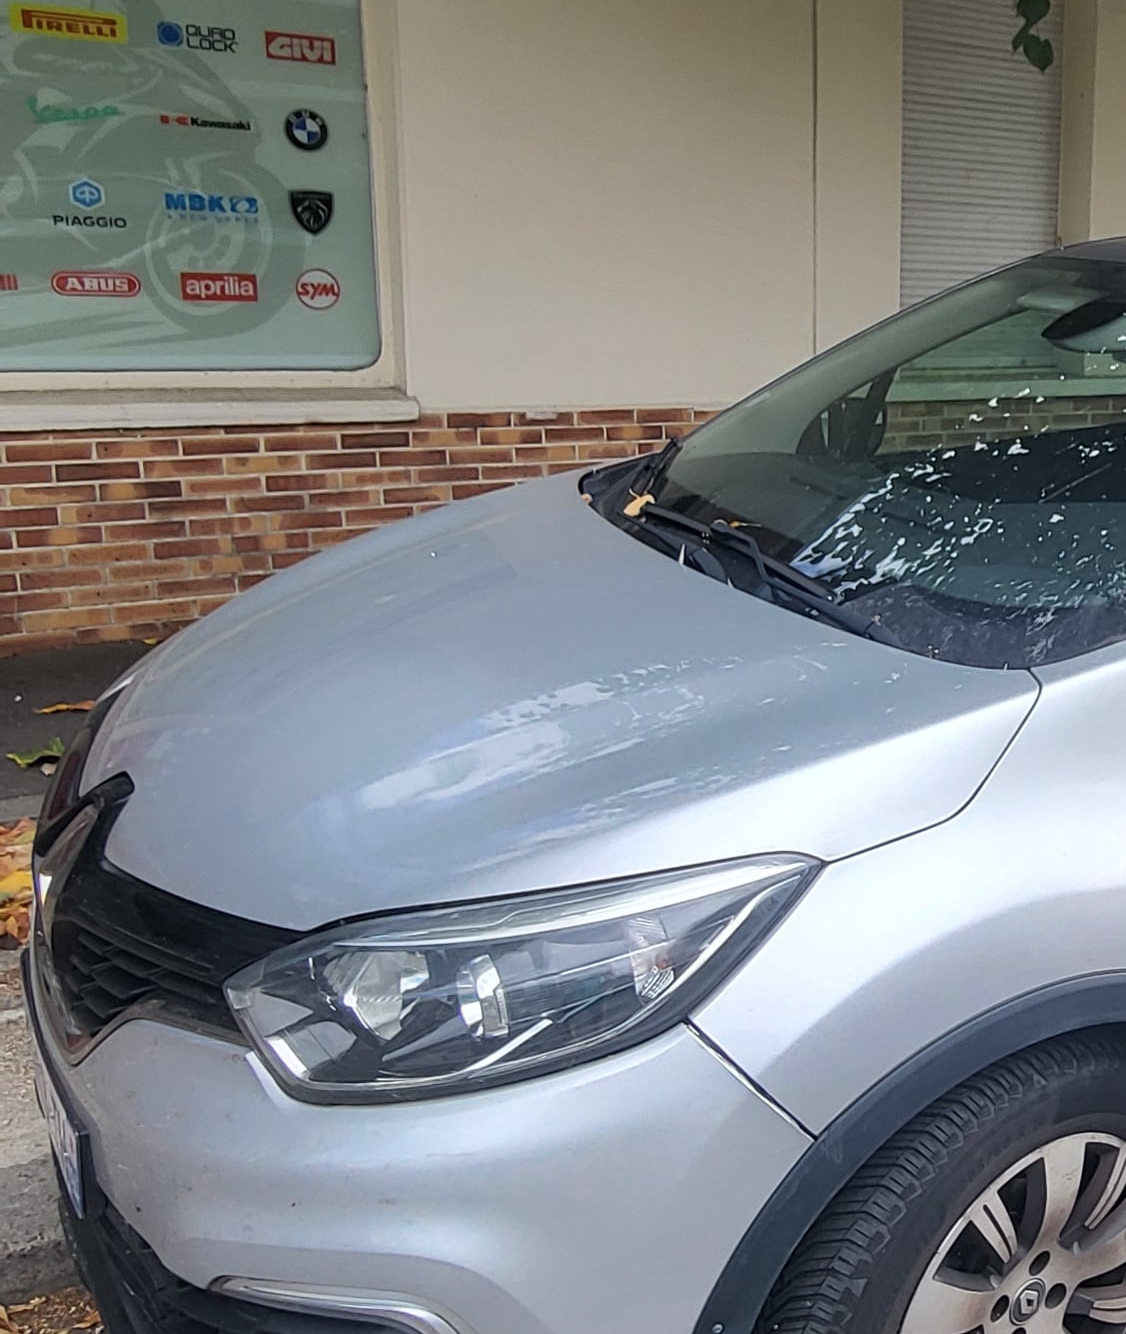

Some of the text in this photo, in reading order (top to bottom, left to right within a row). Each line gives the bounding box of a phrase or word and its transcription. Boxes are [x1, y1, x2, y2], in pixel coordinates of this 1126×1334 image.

[21, 9, 117, 38] PIRELLI
[185, 24, 236, 41] QUAD
[187, 37, 237, 54] LOCK
[268, 36, 333, 63] GIVI
[27, 94, 125, 124] Vespa
[190, 117, 251, 132] Kawasaki
[164, 192, 227, 213] MBK
[52, 214, 127, 228] PIAGGIO
[65, 277, 129, 292] ABUS
[185, 276, 254, 298] aprilia
[299, 282, 339, 300] SYM
